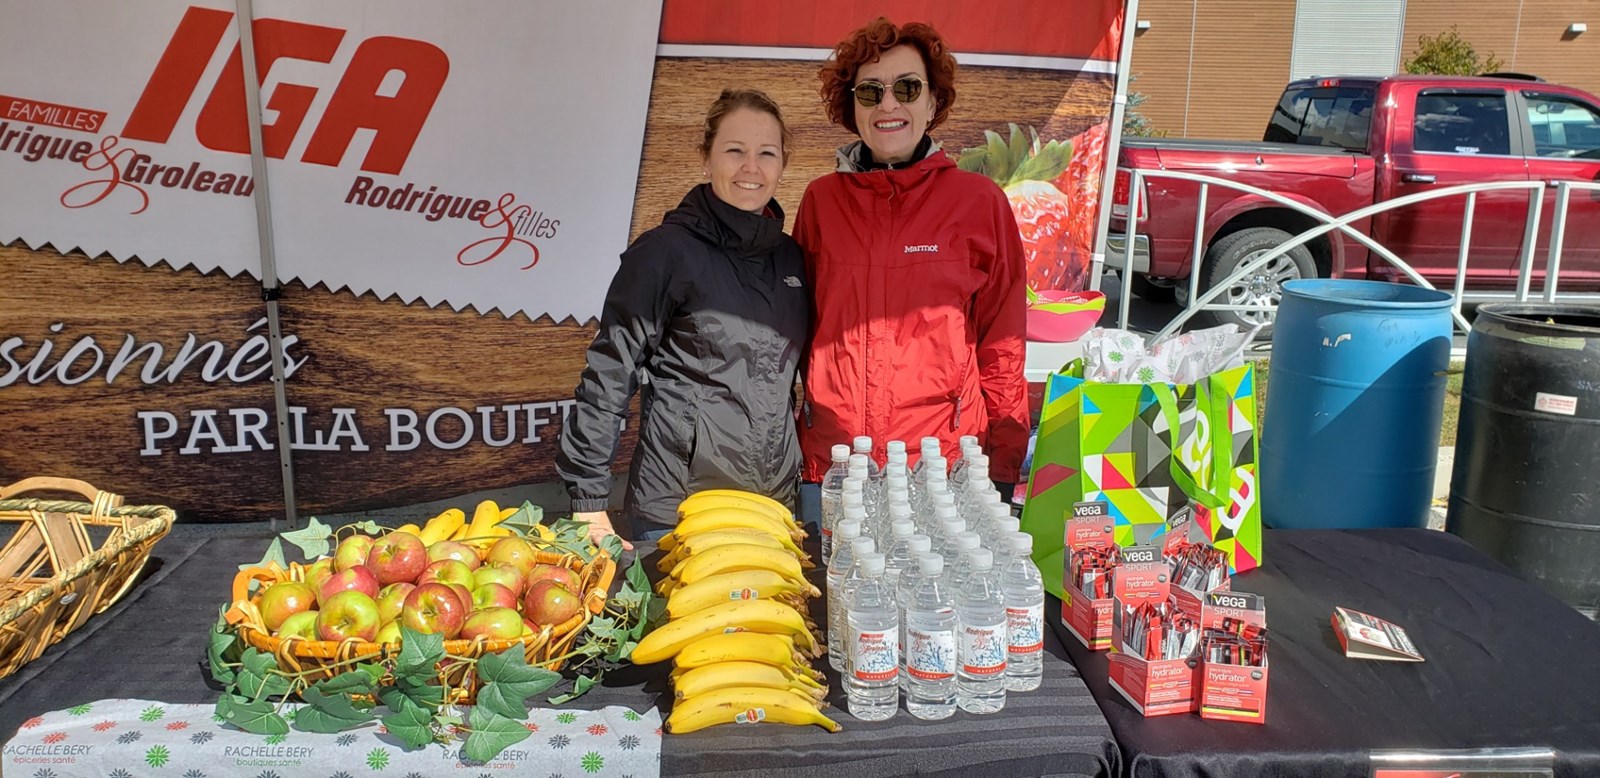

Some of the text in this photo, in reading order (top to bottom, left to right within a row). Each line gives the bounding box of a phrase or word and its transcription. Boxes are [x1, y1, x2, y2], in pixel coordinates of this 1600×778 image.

[120, 5, 450, 176] IGA
[7, 99, 101, 131] FAMILLES
[345, 176, 490, 222] Rodrigue
[511, 209, 561, 239] filles
[904, 244, 938, 253] Marmot
[138, 408, 276, 456] PAR
[287, 406, 369, 451] LA
[1074, 506, 1101, 516] vega
[1123, 551, 1154, 562] vega
[1126, 563, 1153, 572] SPORT
[1126, 580, 1156, 589] hydrator
[1212, 594, 1247, 609] vega
[1214, 607, 1244, 617] SPORT
[1152, 666, 1184, 679] hydrator
[1208, 672, 1247, 682] hydrator
